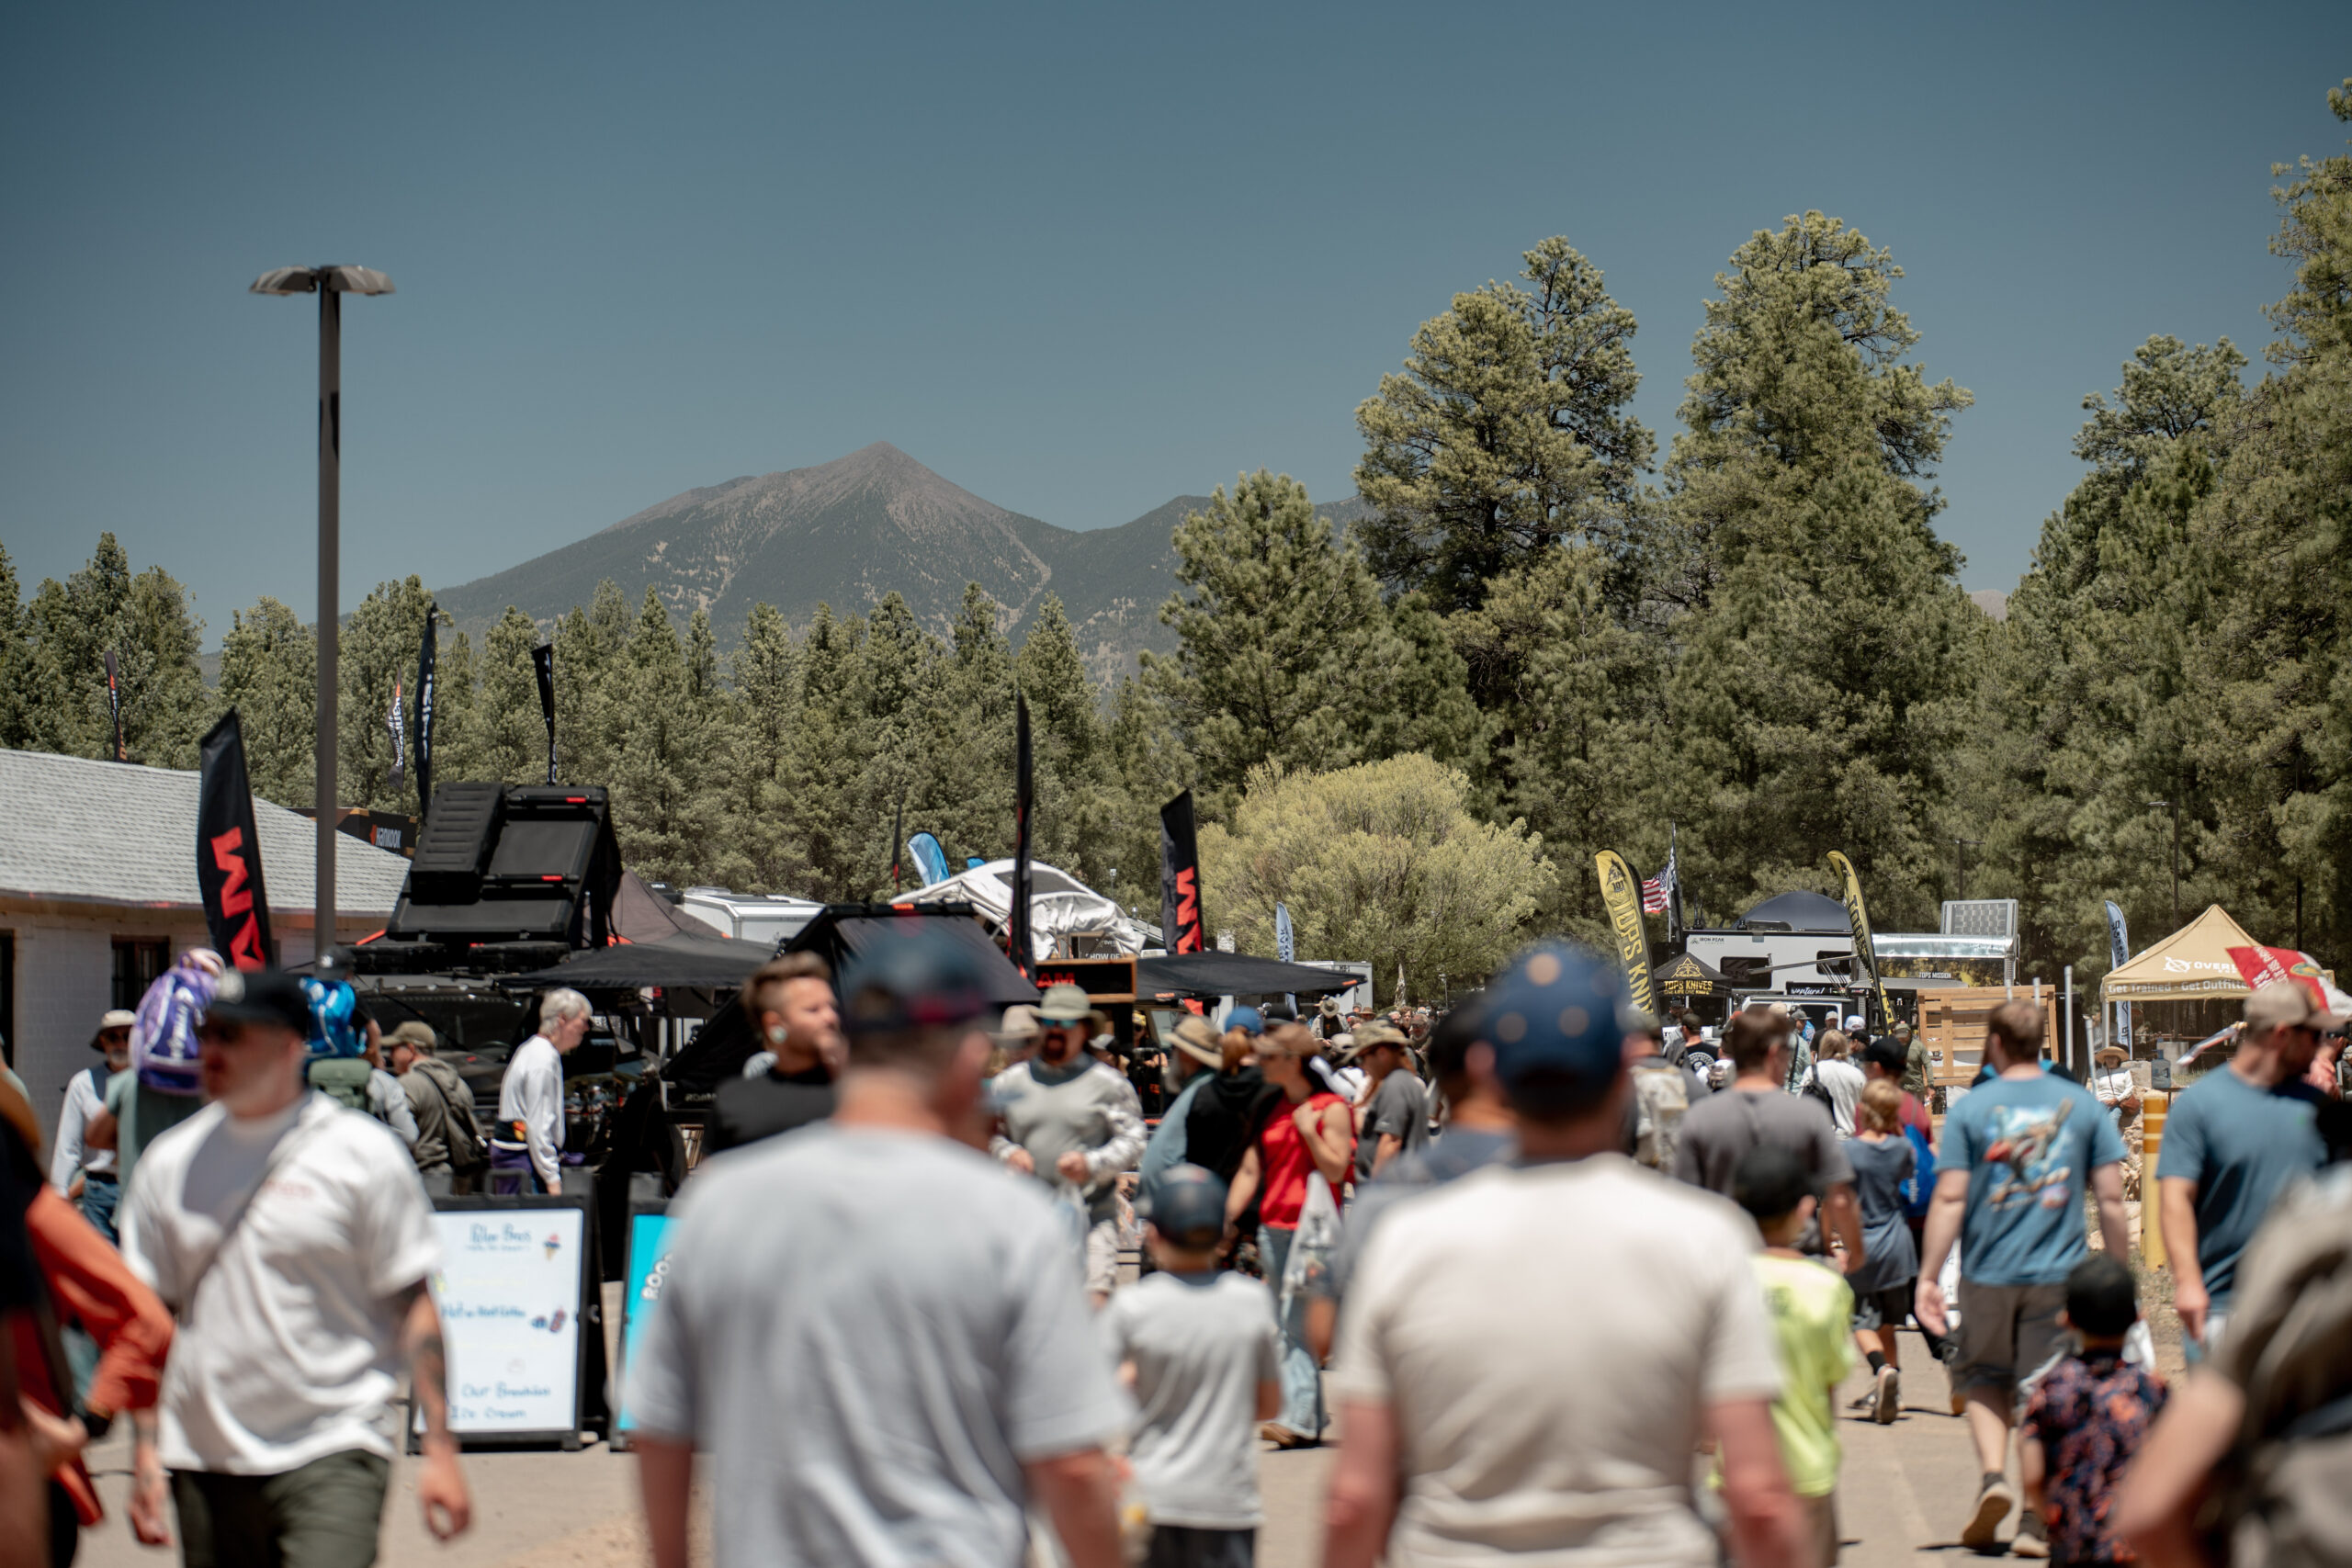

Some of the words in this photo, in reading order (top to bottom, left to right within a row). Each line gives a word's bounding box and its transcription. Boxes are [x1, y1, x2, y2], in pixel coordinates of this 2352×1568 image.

[1612, 895, 1643, 961] TOPS
[1664, 980, 1684, 990] TOPS
[1685, 980, 1713, 990] KNIVES
[2109, 985, 2127, 993] Get
[2132, 984, 2171, 992] Trained
[2181, 982, 2200, 991] Get
